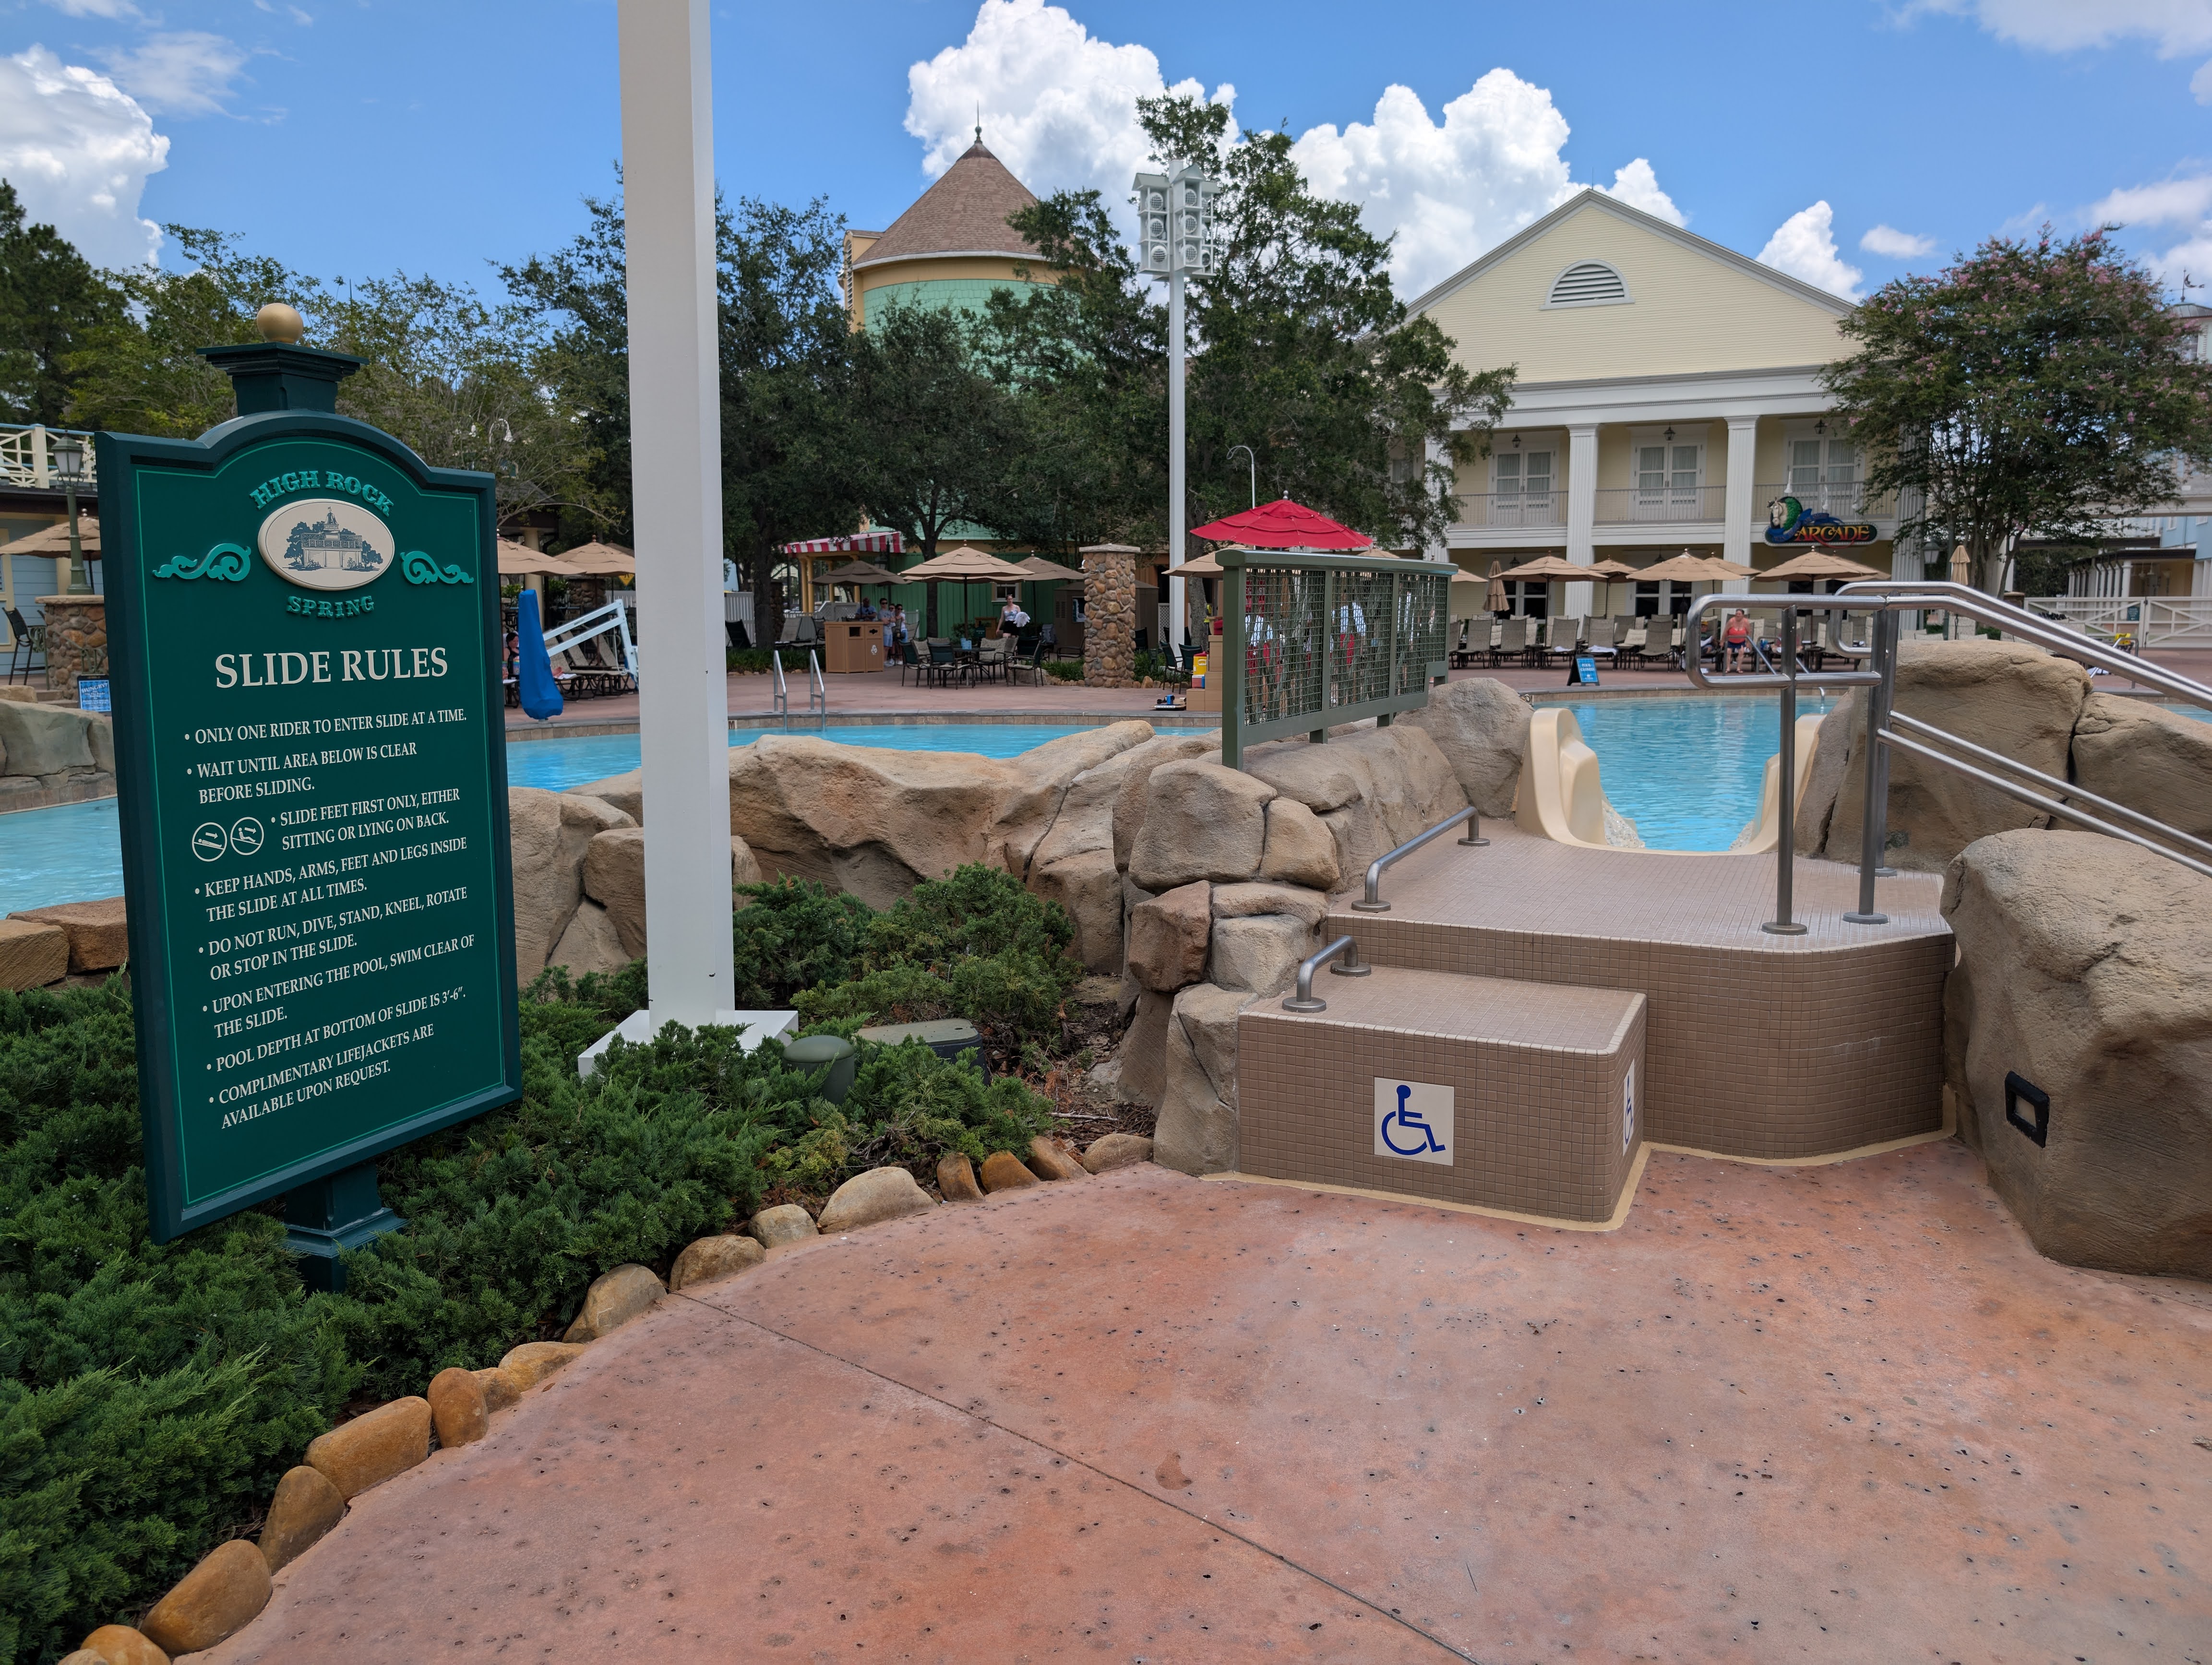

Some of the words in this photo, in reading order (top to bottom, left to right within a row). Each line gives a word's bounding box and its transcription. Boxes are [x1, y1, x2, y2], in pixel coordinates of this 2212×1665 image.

[250, 470, 320, 510] HIGH
[325, 471, 394, 517] ROCK
[1794, 525, 1870, 547] ARCADE
[287, 595, 374, 618] SPRING
[82, 682, 108, 693] HUNGRY?
[215, 651, 331, 688] SLIDE
[340, 647, 448, 681] RULES
[195, 726, 234, 744] ONLY
[237, 724, 267, 740] ONE
[269, 721, 311, 737] RIDER
[313, 719, 331, 733] TO
[334, 715, 374, 732] ENTER
[376, 713, 409, 728] SLIDE
[411, 712, 425, 725] AT
[428, 711, 436, 724] A
[437, 708, 466, 723] TIME.
[196, 761, 235, 778] WAIT
[237, 756, 280, 773] UNTIL
[283, 752, 319, 769] AREA
[320, 747, 364, 764] BELOW
[366, 746, 377, 760] IS
[380, 742, 417, 758] CLEAR
[198, 784, 252, 804] BEFORE
[256, 777, 315, 797] SLIDING.
[280, 808, 318, 826] SLIDE
[320, 803, 349, 820] FEET
[351, 798, 384, 816] FIRST
[387, 794, 419, 810] ONLY,
[421, 788, 460, 805] EITHER
[282, 829, 335, 850] SITTING
[338, 826, 356, 841] OR
[358, 820, 394, 838] LYING
[396, 816, 414, 831] ON
[416, 811, 449, 828] BACK.
[204, 878, 240, 897] KEEP
[243, 868, 296, 890] HANDS,
[299, 860, 339, 880] ARMS,
[341, 854, 369, 872] FEET
[371, 849, 398, 866] AND
[400, 844, 428, 860] LEGS
[430, 837, 467, 855] INSIDE
[206, 903, 235, 922] THE
[239, 895, 277, 916] SLIDE
[280, 891, 297, 907] AT
[300, 886, 324, 903] ALL
[326, 878, 367, 897] TIMES.
[208, 938, 231, 956] DO
[234, 930, 264, 950] NOT
[267, 923, 300, 942] RUN,
[302, 915, 337, 934] DIVE,
[339, 905, 383, 926] STAND,
[385, 896, 424, 916] KNEEL,
[426, 886, 467, 907] ROTATE
[210, 963, 232, 980] OR
[234, 953, 269, 975] STOP
[272, 949, 287, 965] IN
[290, 942, 316, 961] THE
[319, 934, 357, 954] SLIDE.
[212, 990, 252, 1013] UPON
[255, 973, 323, 1002] ENTERING
[325, 965, 350, 983] THE
[353, 957, 388, 976] POOL,
[390, 947, 422, 967] SWIM
[424, 938, 459, 958] CLEAR
[461, 934, 474, 948] OF
[214, 1018, 243, 1038] THE
[246, 1006, 287, 1030] SLIDE.
[216, 1048, 254, 1072] POOL
[257, 1033, 301, 1059] DEPTH
[304, 1028, 320, 1045] AT
[323, 1011, 376, 1039] BOTTOM
[378, 1006, 393, 1022] OF
[395, 996, 428, 1017] SLIDE
[430, 993, 440, 1007] IS
[219, 1055, 334, 1104] COMPLIMENTARY
[336, 1031, 410, 1066] LIFEJACKETS
[412, 1023, 434, 1042] ARE
[221, 1092, 294, 1129] AVAILABLE
[296, 1078, 332, 1102] UPON
[335, 1059, 391, 1089] REQUEST.
